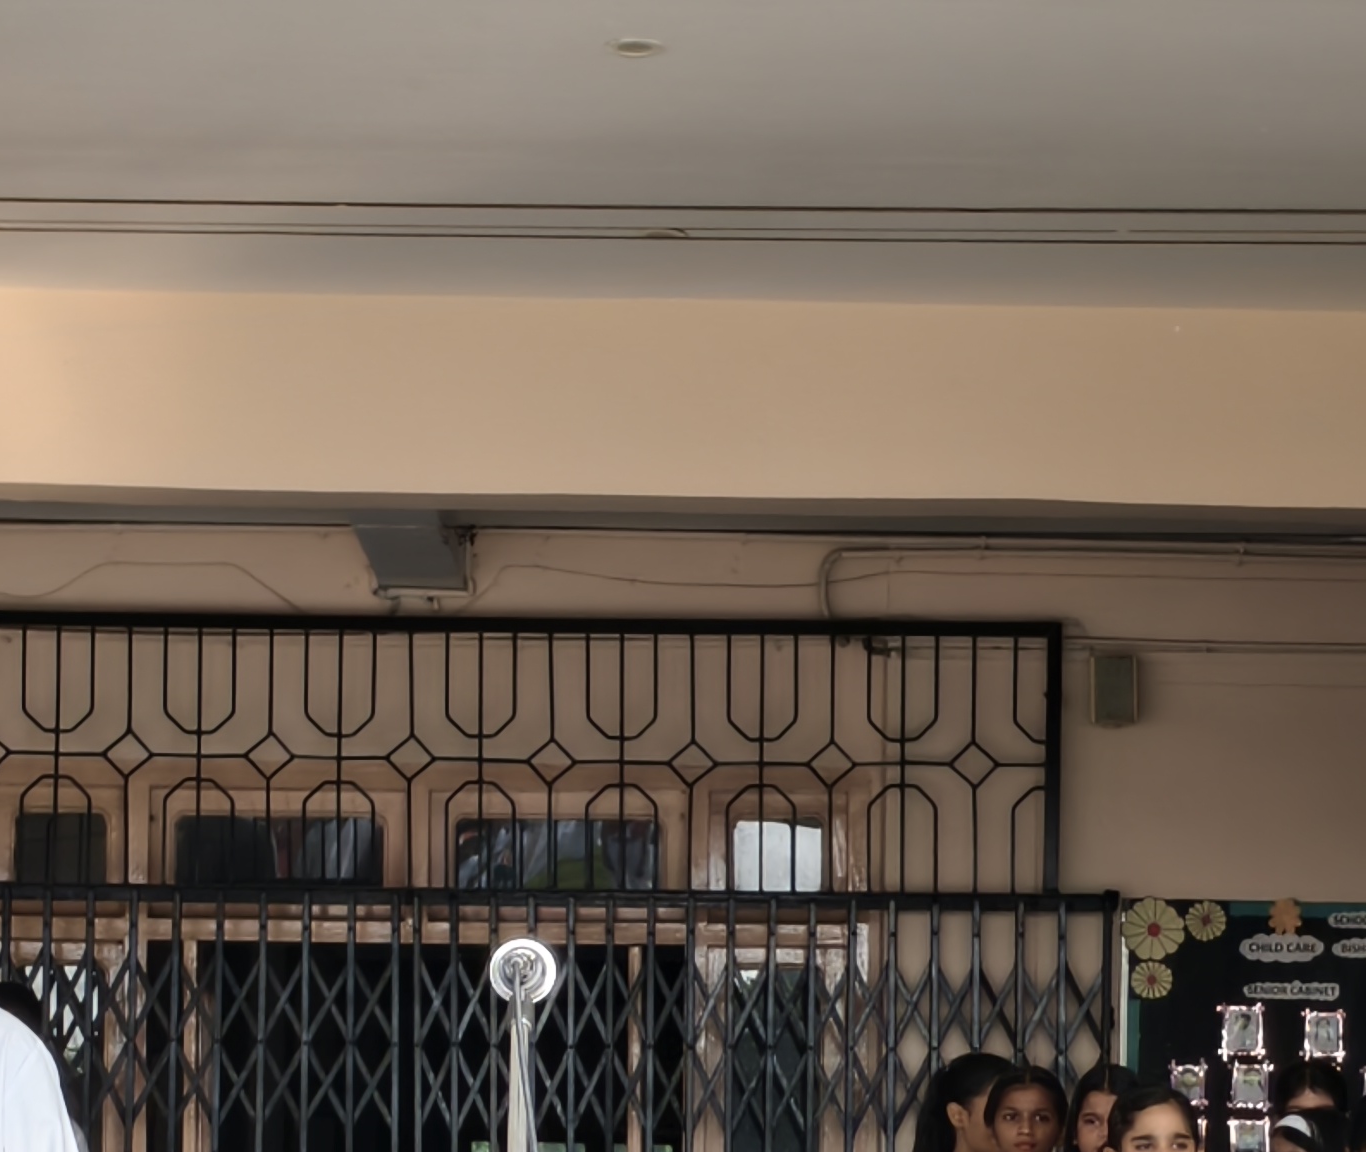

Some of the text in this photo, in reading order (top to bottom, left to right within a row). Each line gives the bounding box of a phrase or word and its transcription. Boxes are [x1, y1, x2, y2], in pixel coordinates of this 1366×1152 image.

[1248, 942, 1284, 953] CHILD
[1286, 942, 1317, 953] CARE
[1247, 984, 1336, 997] SENIOR CABINET
